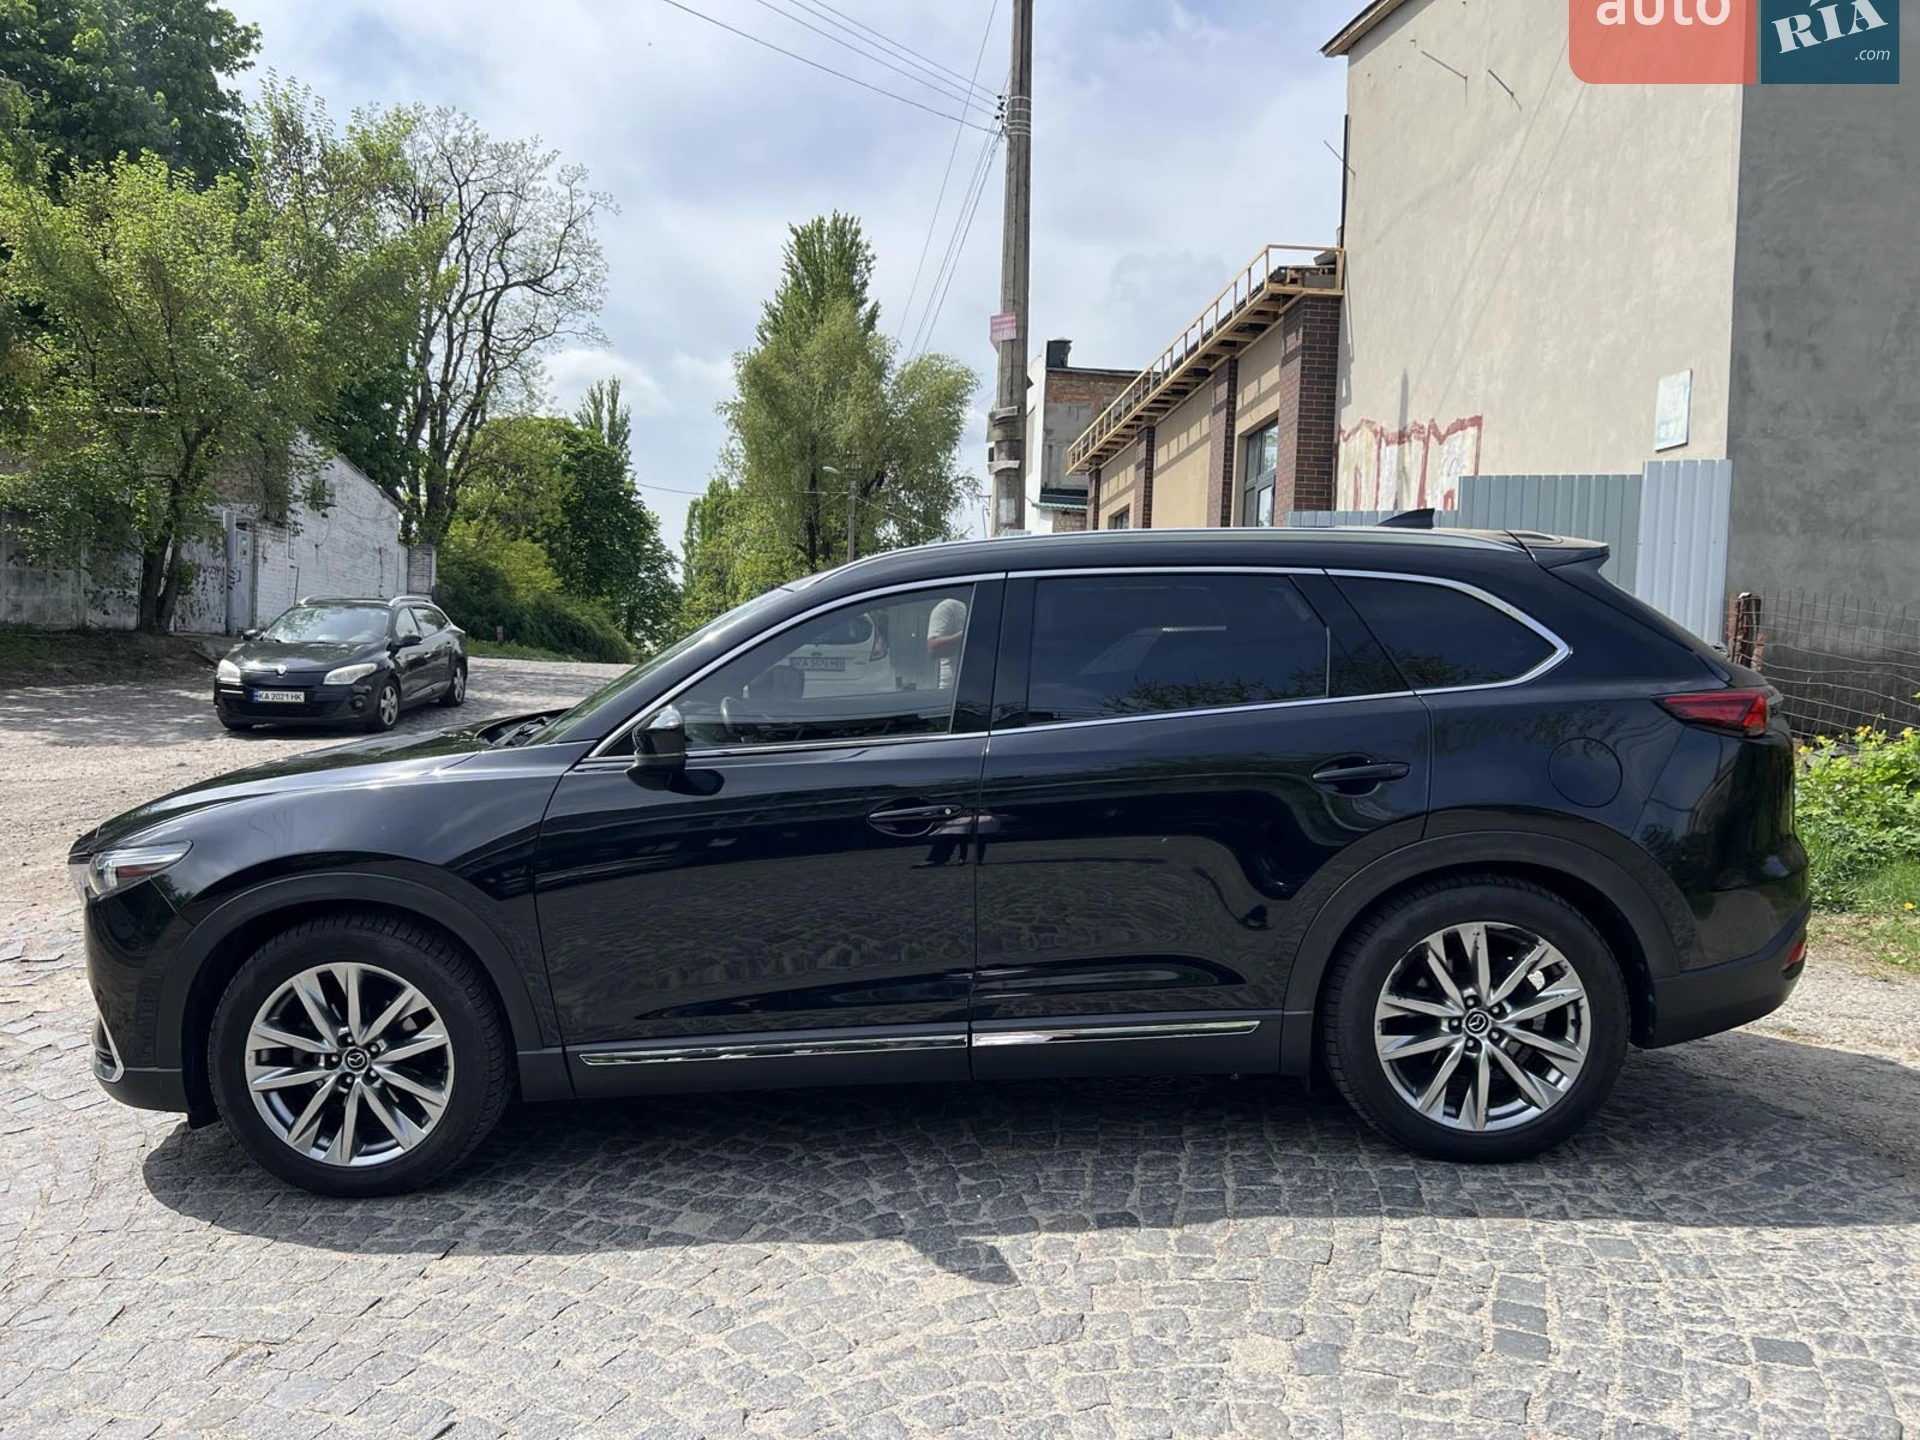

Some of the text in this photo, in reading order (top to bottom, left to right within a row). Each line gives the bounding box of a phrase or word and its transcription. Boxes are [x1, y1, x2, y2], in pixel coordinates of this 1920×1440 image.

[258, 692, 303, 702] KA 2021 HK
